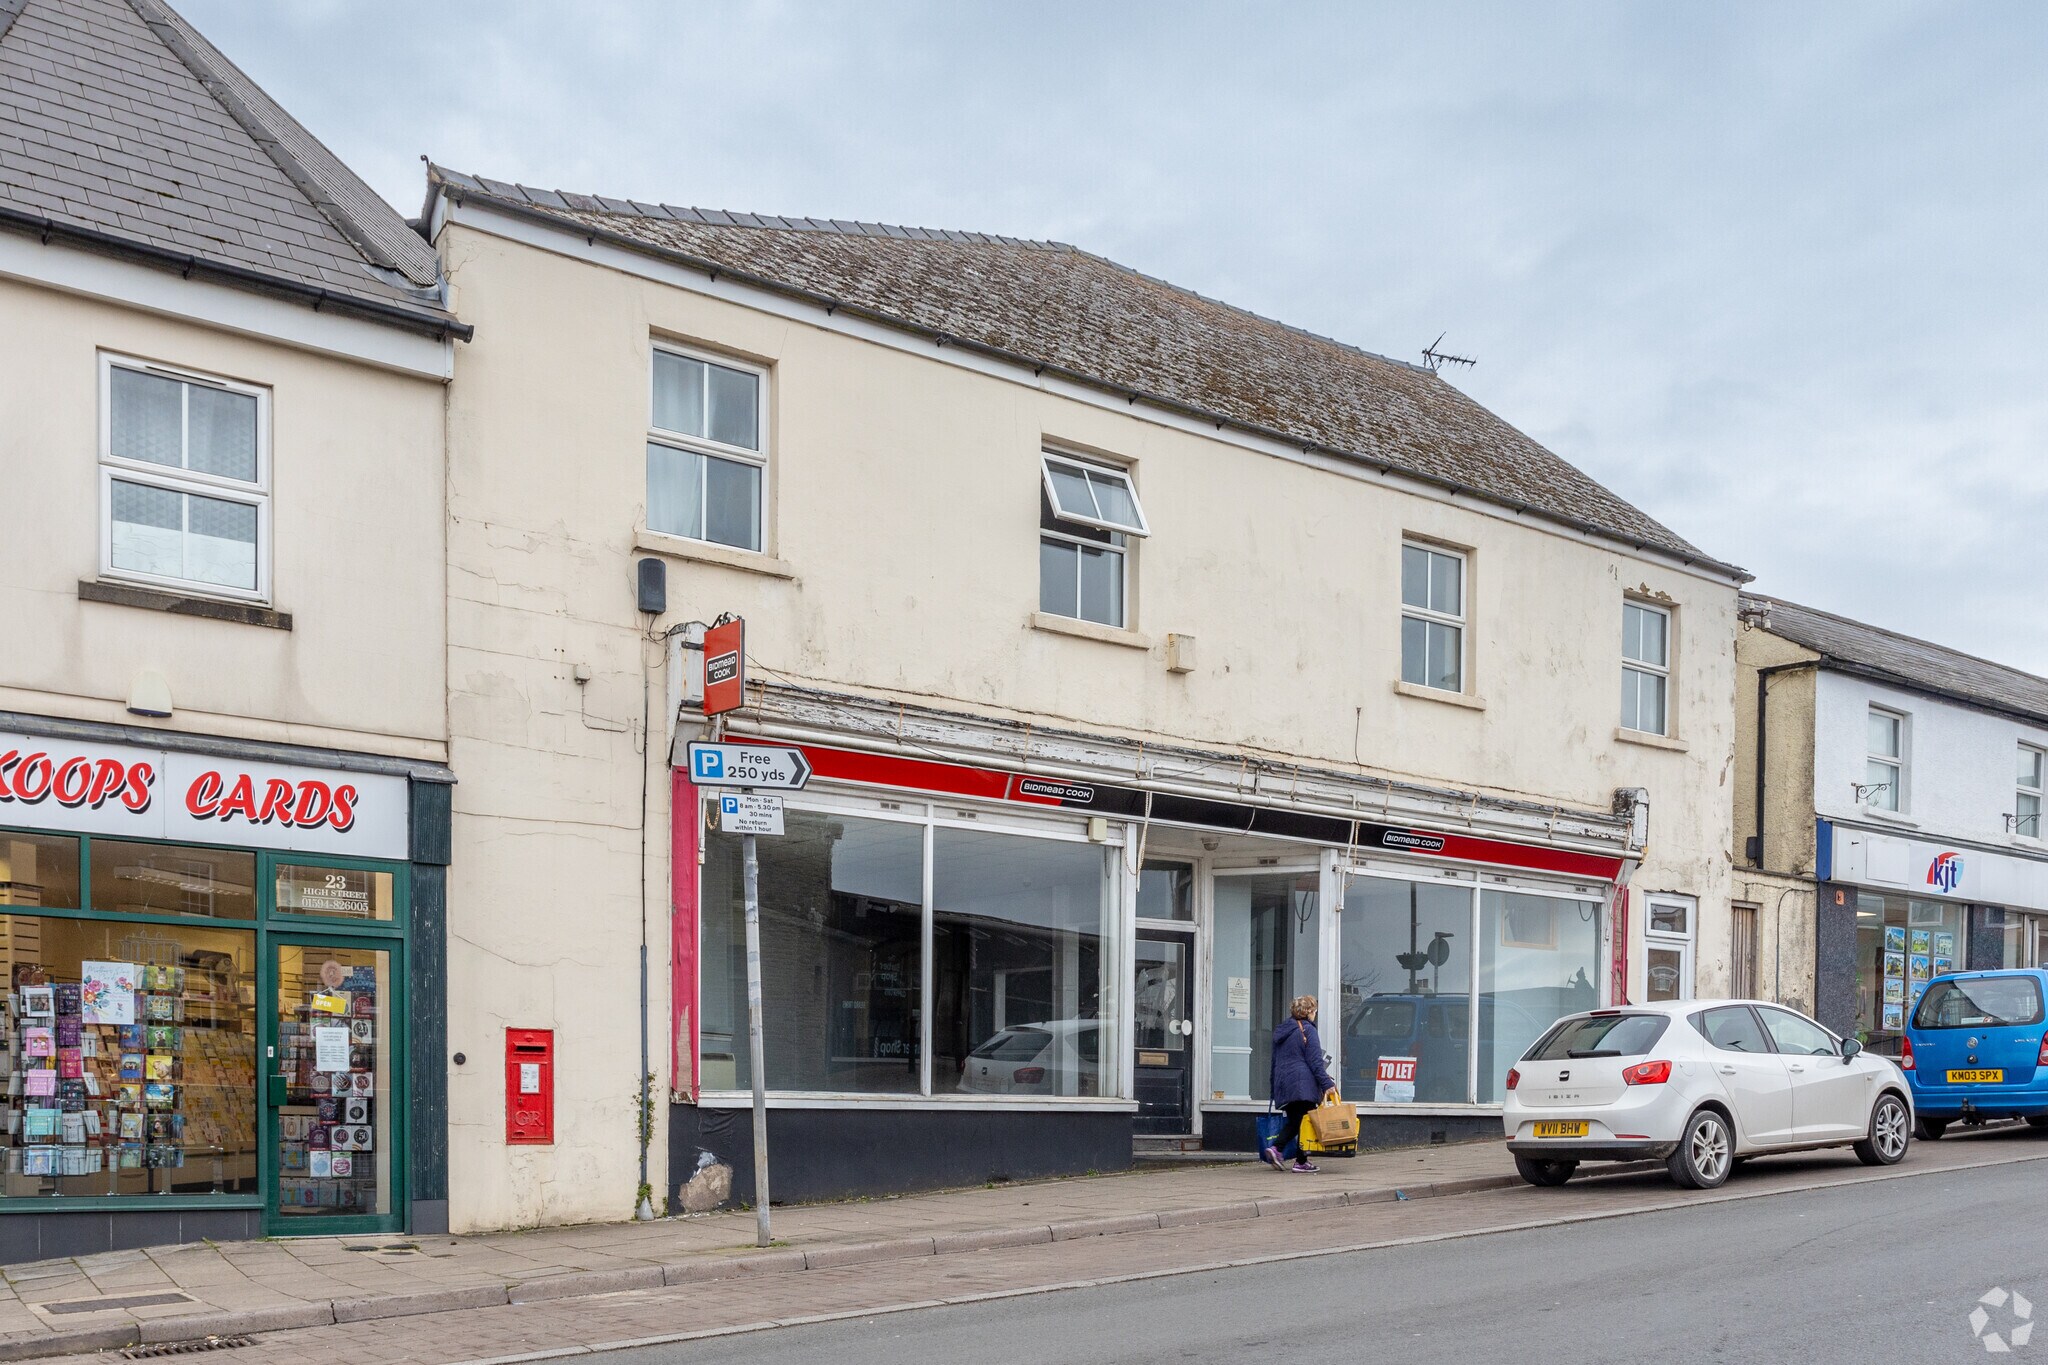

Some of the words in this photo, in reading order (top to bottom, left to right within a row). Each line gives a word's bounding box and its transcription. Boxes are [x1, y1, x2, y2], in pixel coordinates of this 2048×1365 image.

[713, 667, 731, 679] COOK
[701, 752, 719, 775] P
[740, 752, 771, 765] Free
[728, 766, 758, 779] 250
[761, 768, 786, 782] yds
[1066, 788, 1091, 798] COOK
[185, 770, 358, 831] CARDS
[725, 799, 736, 812] P
[1420, 839, 1442, 848] COOK
[1933, 857, 1957, 893] kjt
[325, 874, 347, 890] 23
[303, 887, 329, 897] HIGH
[330, 890, 368, 899] STREET
[315, 999, 332, 1008] OPEN
[1380, 1062, 1394, 1079] TO
[1395, 1063, 1414, 1080] LET
[1951, 1071, 1977, 1081] KM03
[1979, 1070, 1999, 1080] SPX
[514, 1110, 545, 1127] GR
[1540, 1123, 1558, 1135] WV11
[1560, 1122, 1581, 1134] BHW
